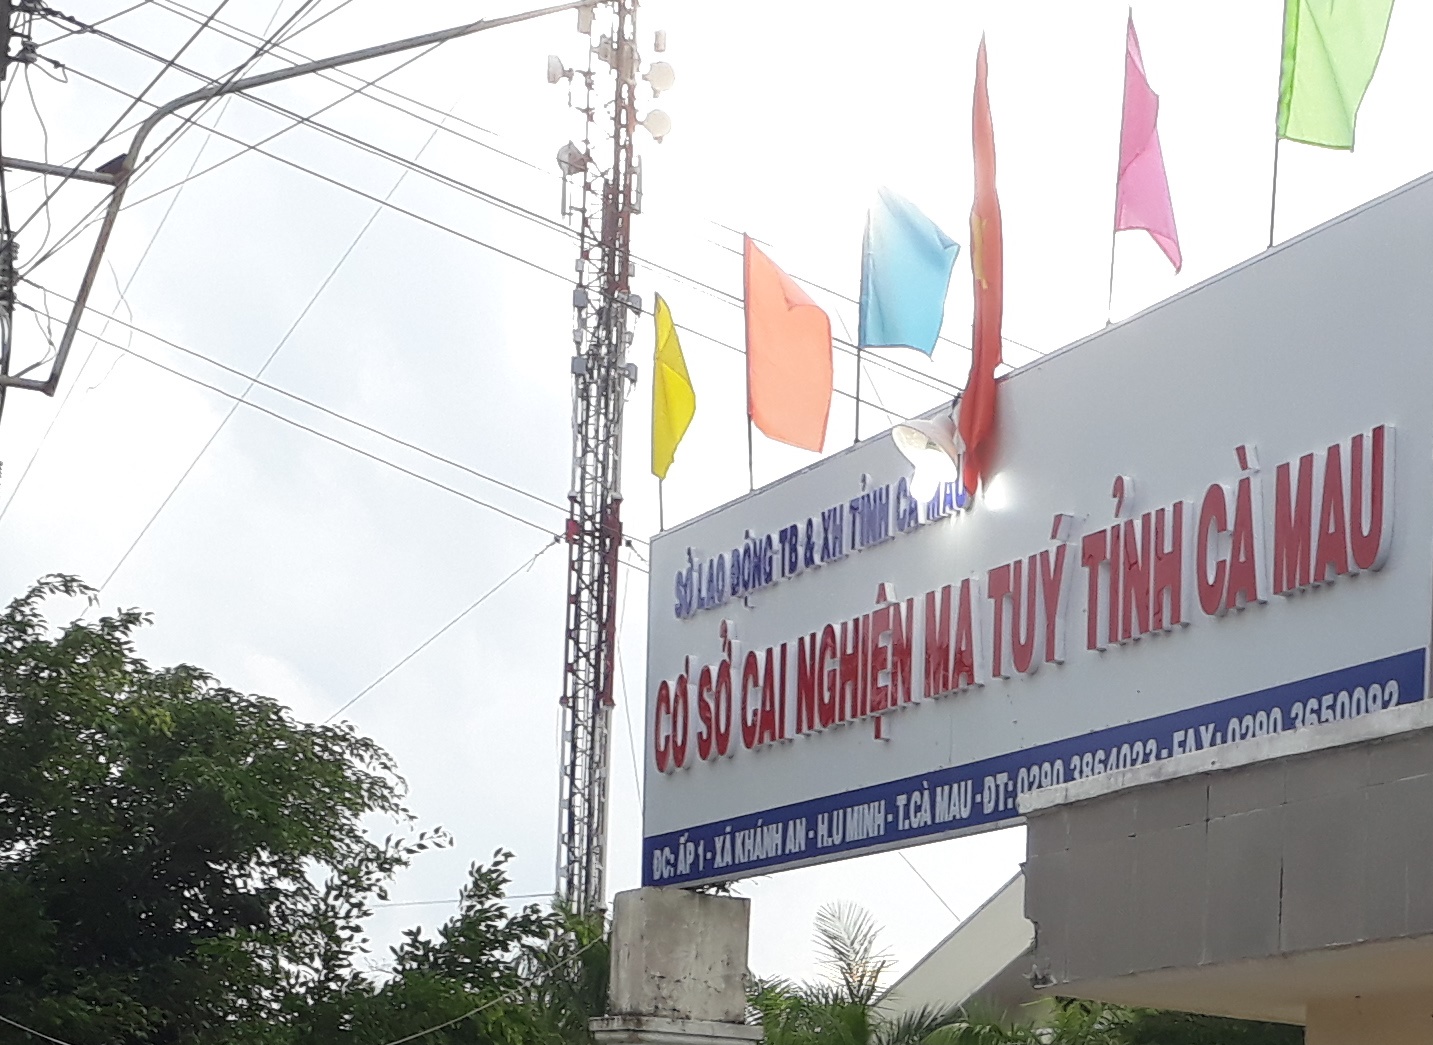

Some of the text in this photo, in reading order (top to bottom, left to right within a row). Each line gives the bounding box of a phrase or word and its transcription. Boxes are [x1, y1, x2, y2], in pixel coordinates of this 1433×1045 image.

[655, 424, 1386, 773] CƠ SỞ CAI NGHIỆN MA TUÝ TỈNH CÀ MAU
[675, 547, 695, 618] SỞ
[698, 553, 726, 609] LAO
[730, 529, 774, 607] ĐỘNG
[779, 524, 798, 578] TB
[804, 518, 815, 568] &
[821, 503, 845, 562] XH
[850, 473, 890, 550] TỈNH
[653, 846, 675, 880] ĐC:
[677, 832, 695, 875] ẤP
[698, 840, 705, 871] 1
[735, 818, 783, 864] KHÁNH
[785, 817, 807, 855] AN
[846, 800, 886, 842] MINH
[896, 780, 932, 830] T.CÀ
[935, 779, 973, 823] MAU
